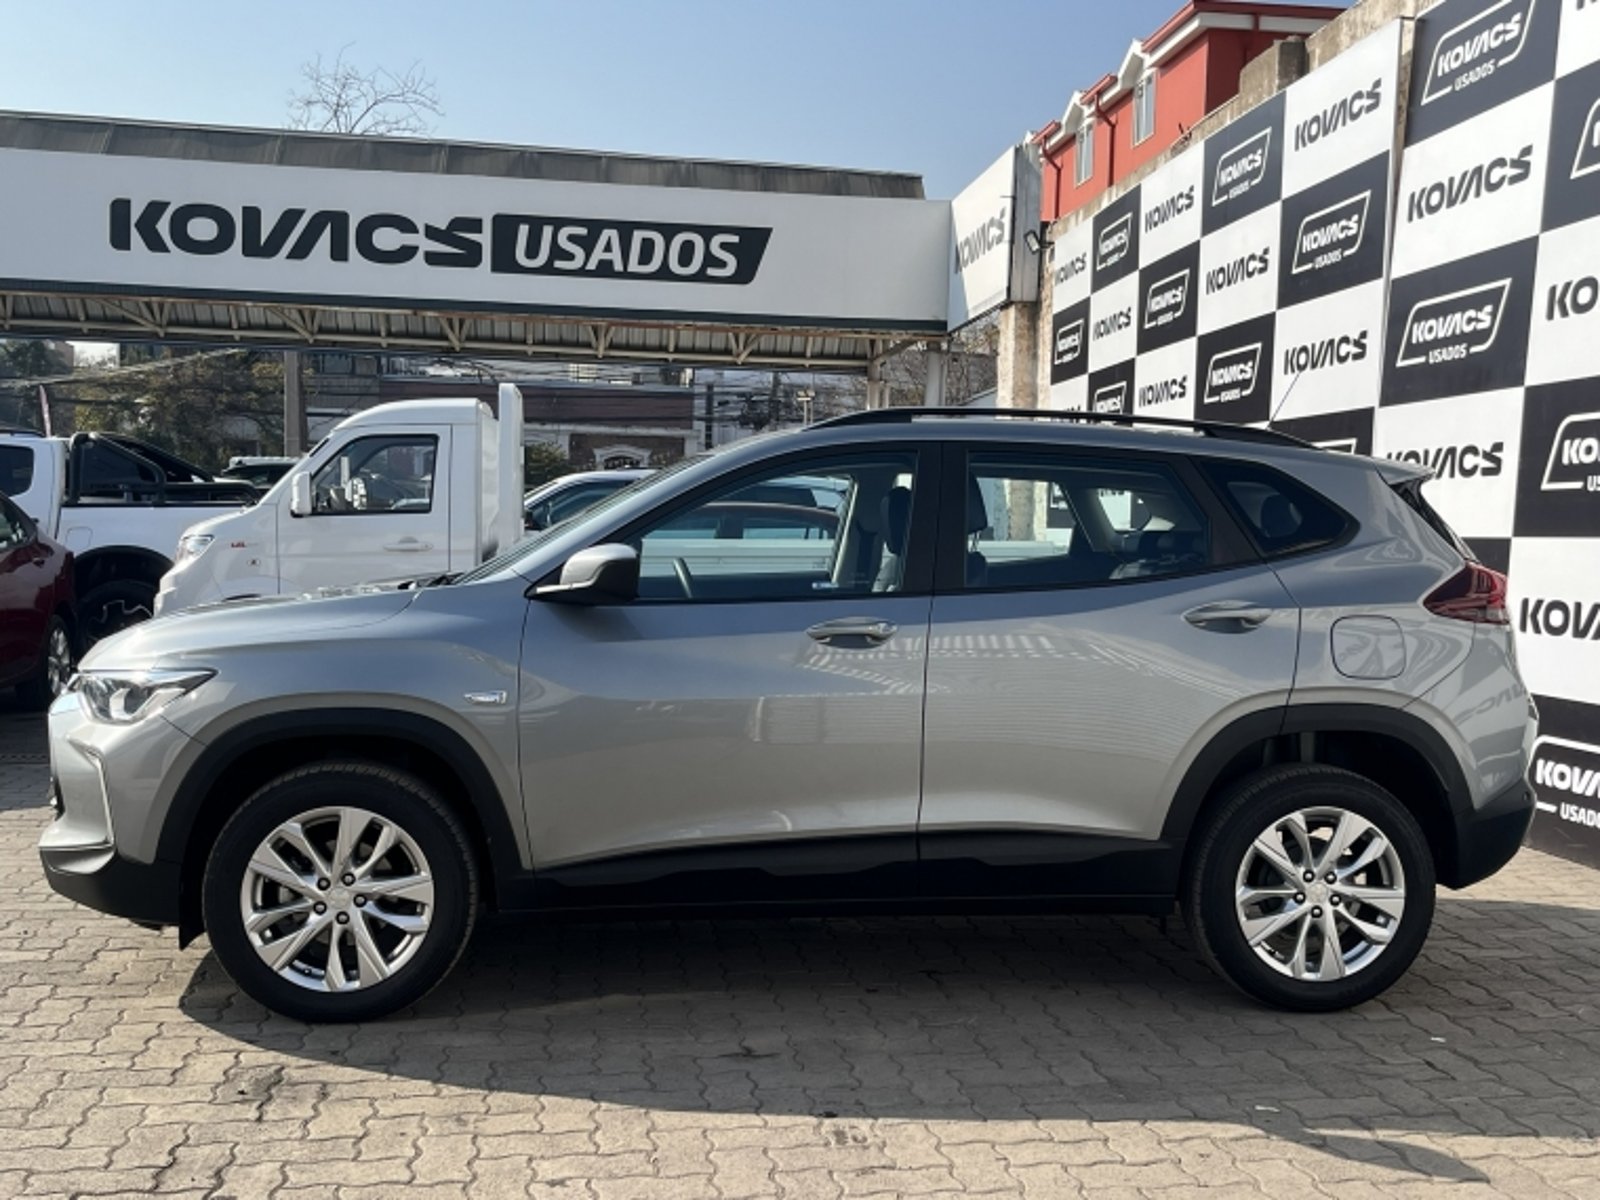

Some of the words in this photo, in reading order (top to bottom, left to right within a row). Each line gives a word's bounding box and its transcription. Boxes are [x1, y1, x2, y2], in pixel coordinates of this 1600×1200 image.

[1437, 12, 1522, 77] KOVACS
[1454, 59, 1496, 90] USADOS
[1295, 78, 1382, 152] KOVACS
[1408, 144, 1533, 223] KOVACS
[1145, 185, 1195, 233] KOVACS
[109, 198, 482, 268] KOVACS
[515, 224, 741, 277] USADOS
[1302, 214, 1359, 253] KOVACS
[1206, 247, 1270, 295] KOVACS
[1546, 276, 1599, 321] KO
[1412, 304, 1493, 344] KOVACS
[1284, 330, 1368, 375] KOVACS
[1429, 343, 1467, 364] USADOS
[1519, 597, 1600, 640] KOV
